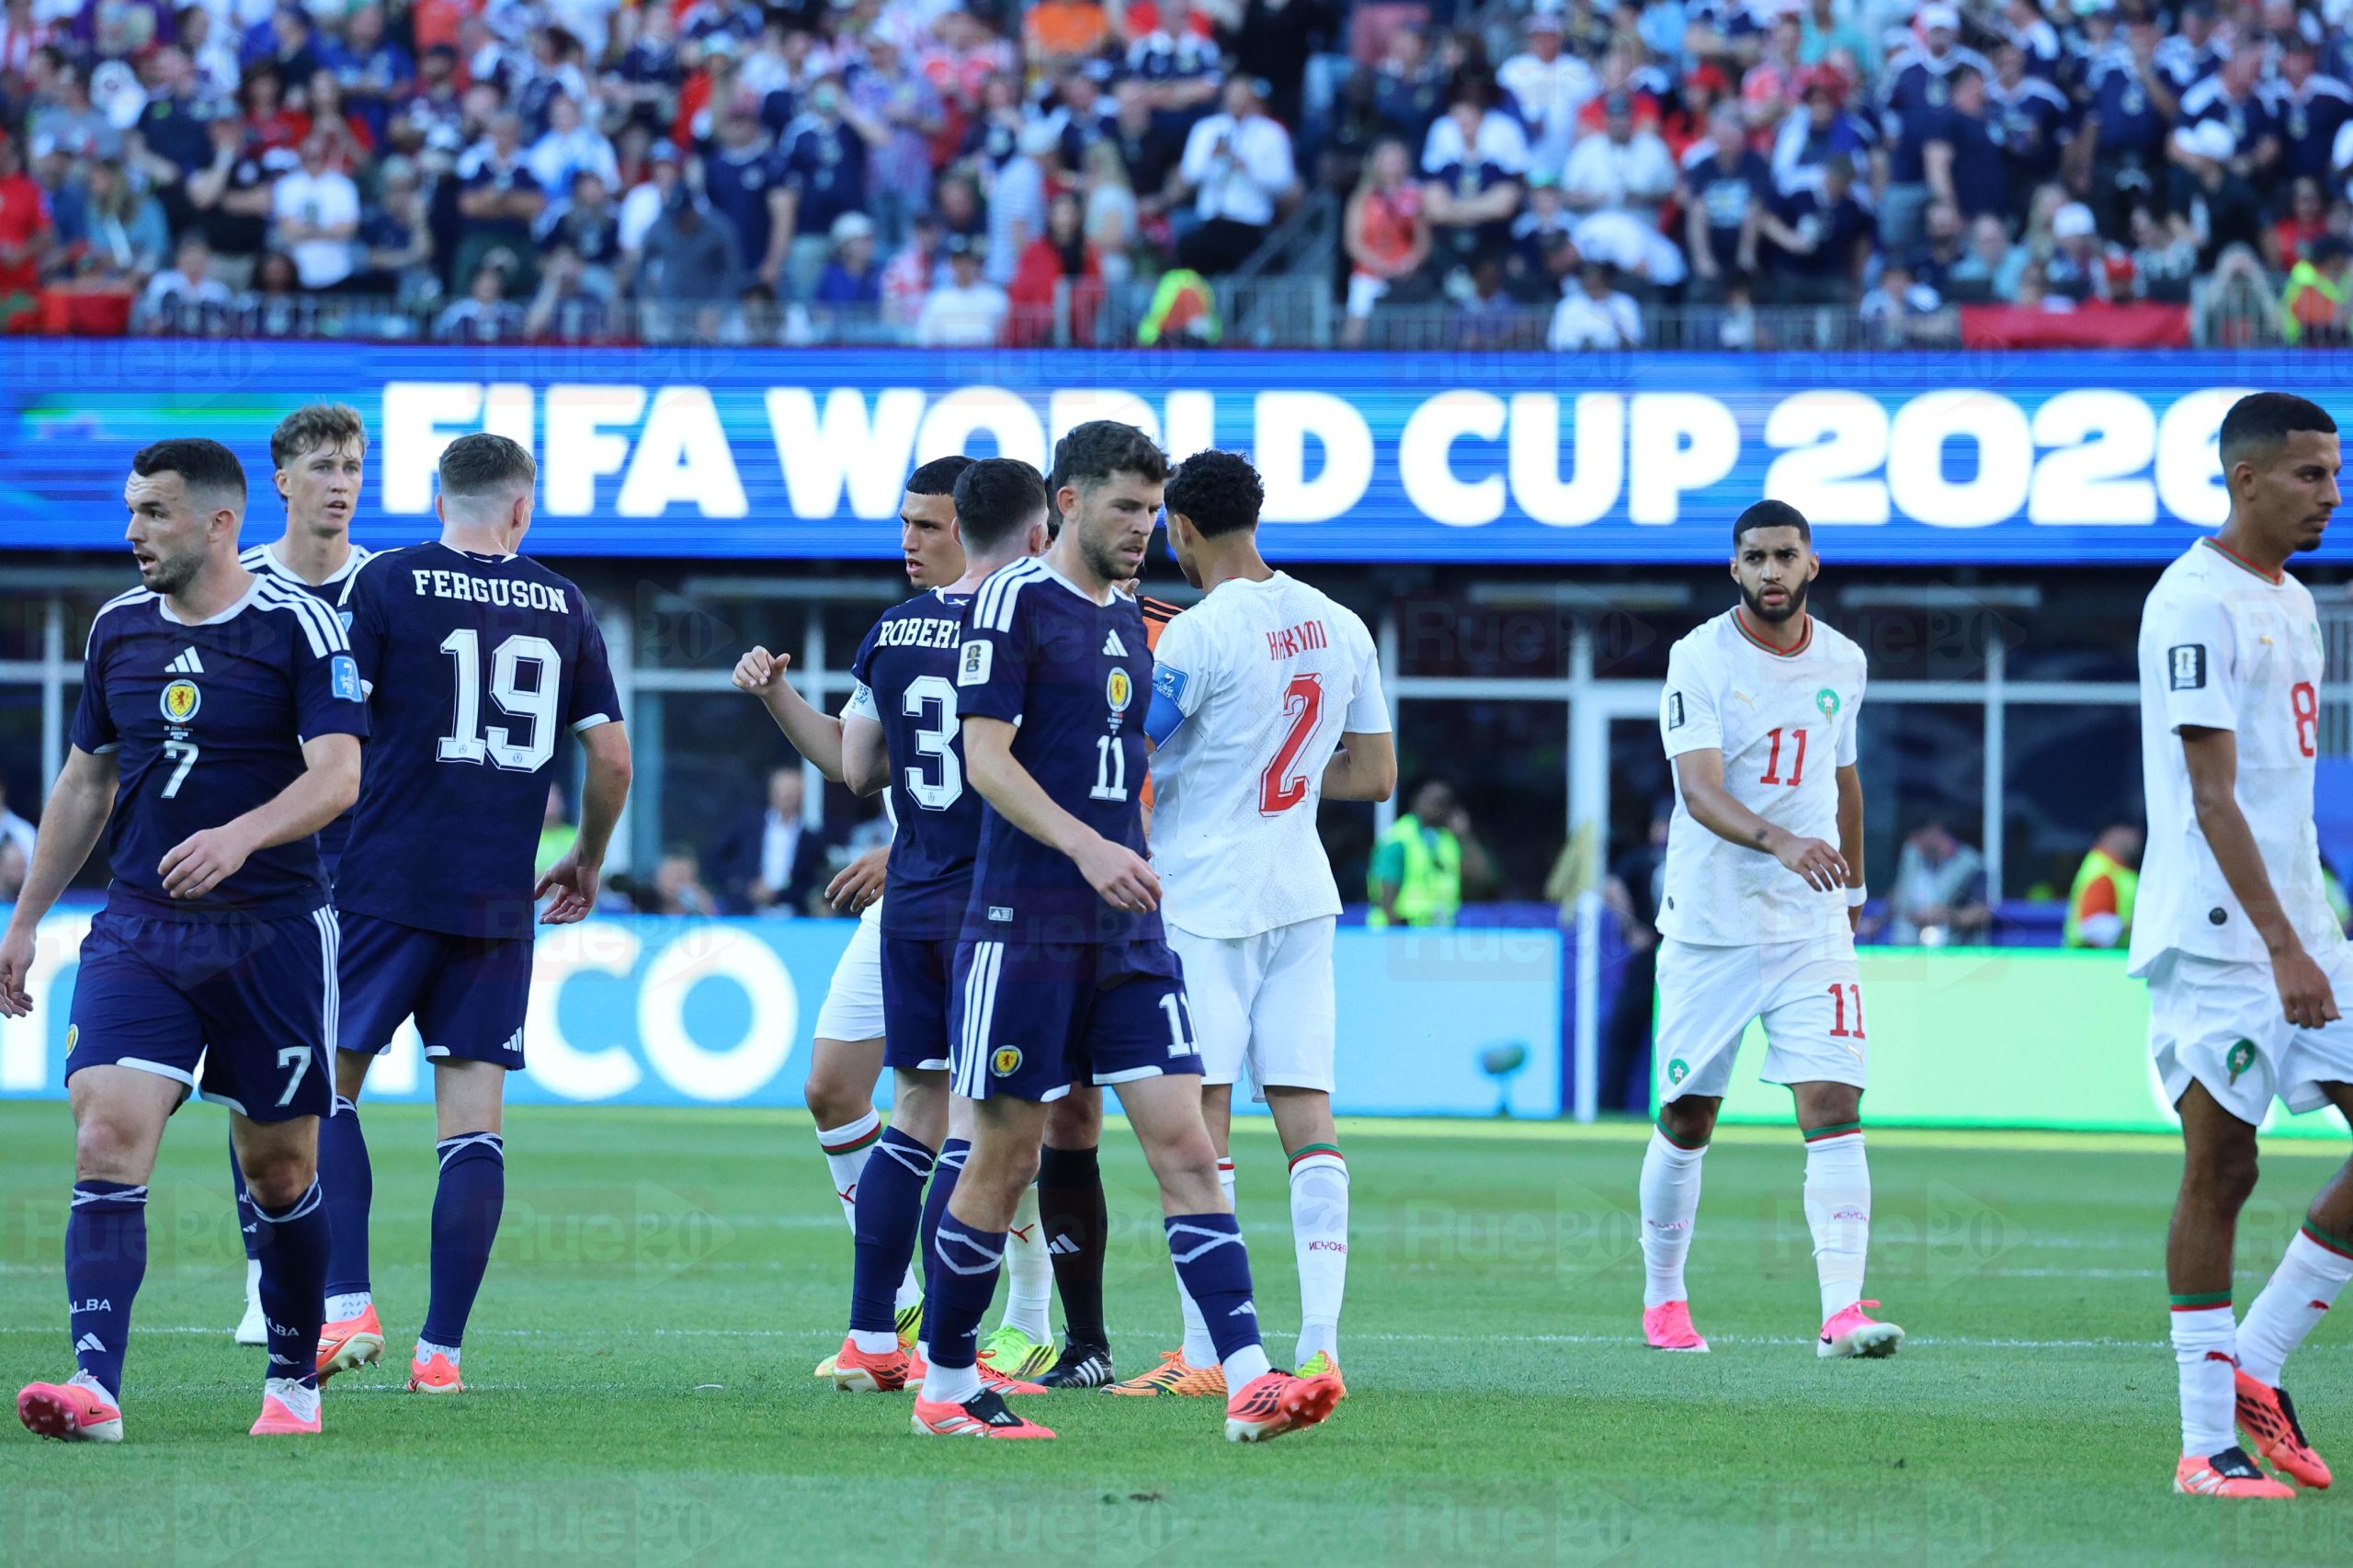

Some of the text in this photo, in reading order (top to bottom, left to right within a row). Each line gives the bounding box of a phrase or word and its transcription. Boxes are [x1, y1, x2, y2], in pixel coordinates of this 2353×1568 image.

[765, 385, 1374, 523] WOD
[1399, 390, 1740, 527] CUP
[412, 569, 569, 614] FERGUSON
[436, 629, 562, 774] 19
[2290, 681, 2317, 758] 8
[161, 740, 199, 799] 7
[903, 675, 963, 812] 3
[1089, 735, 1129, 801] 11
[1258, 673, 1324, 817] 2
[1759, 727, 1808, 787] 11
[1827, 983, 1865, 1040] 11
[276, 1046, 312, 1107] 7
